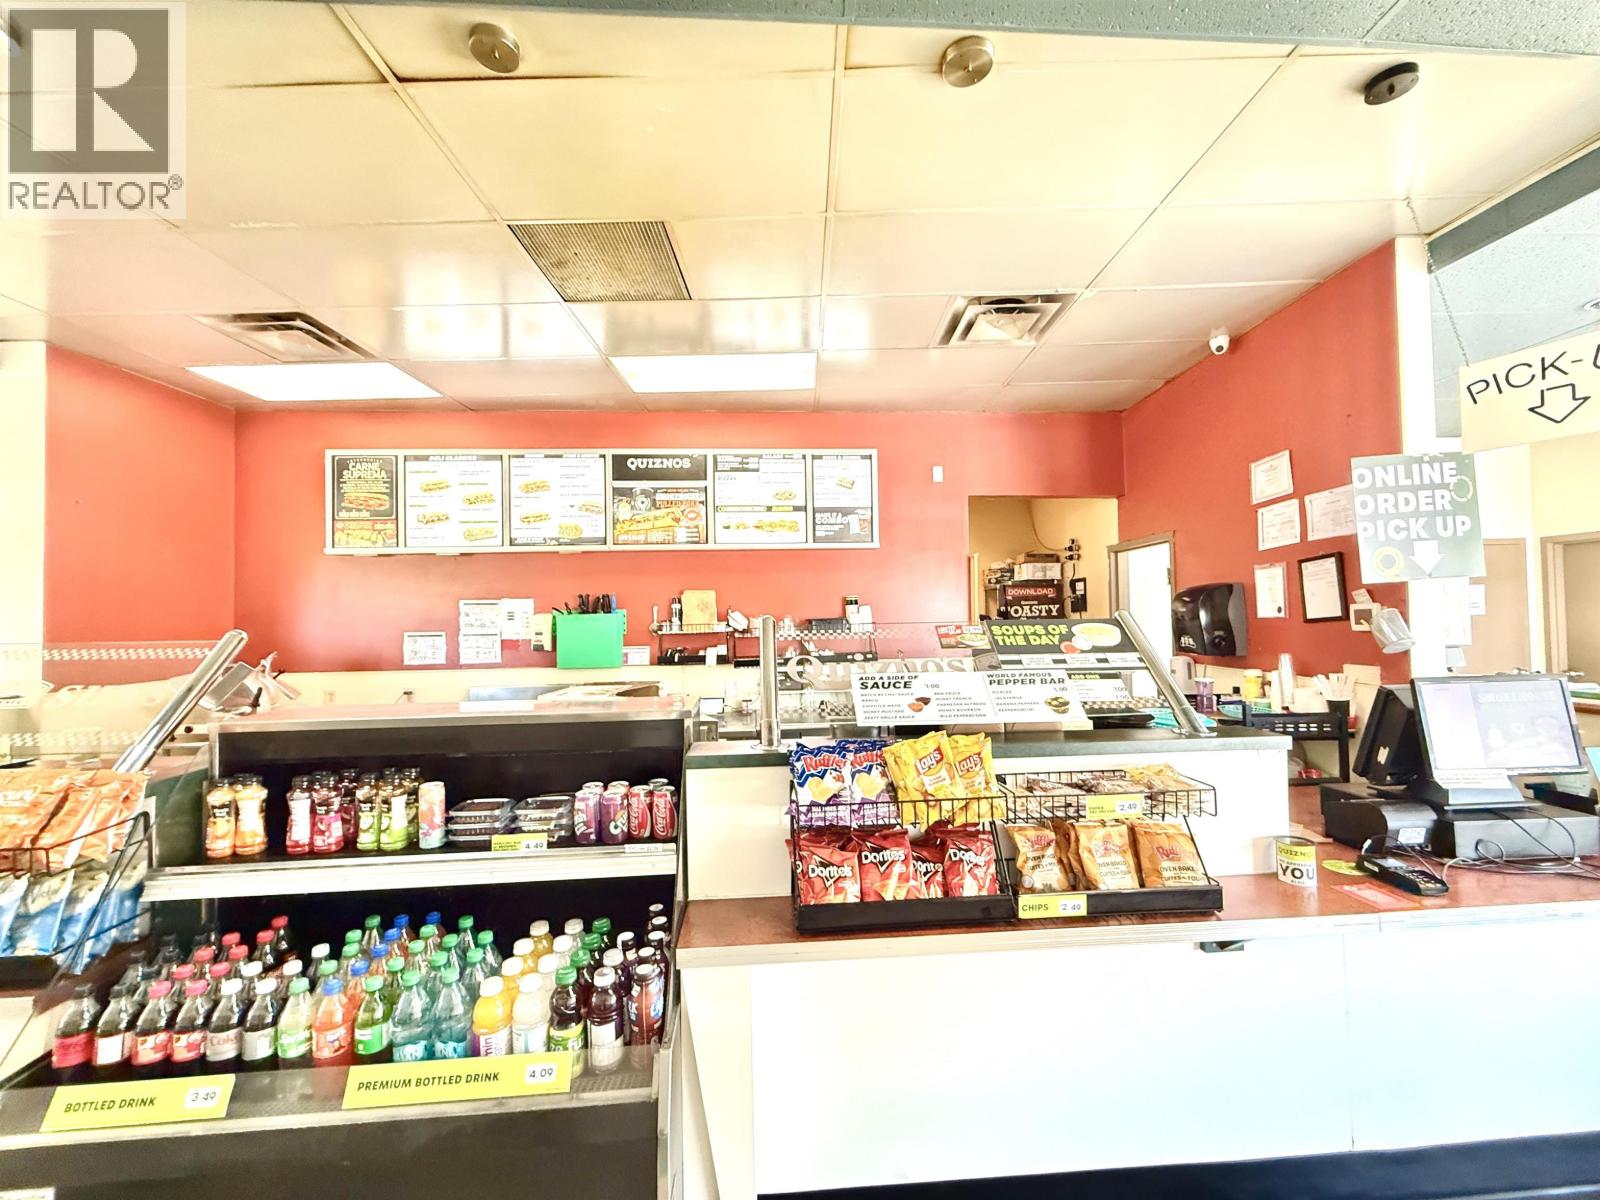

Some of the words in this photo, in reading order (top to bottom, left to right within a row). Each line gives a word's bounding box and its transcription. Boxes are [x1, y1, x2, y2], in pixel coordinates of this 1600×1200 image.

[627, 457, 691, 470] QUIZNOS
[342, 470, 387, 479] SUPREMA
[1353, 461, 1457, 489] ONLINE
[1355, 489, 1453, 515] ORDER
[1358, 517, 1430, 542] PICK
[1434, 515, 1471, 537] UP
[1007, 587, 1054, 596] DOWNLOAD
[991, 624, 1046, 635] SOUPS
[1047, 624, 1069, 635] OF
[994, 635, 1027, 646] THE
[1028, 634, 1060, 646] DAY
[860, 681, 912, 690] SAUCE
[989, 678, 1036, 686] PEPPER
[1040, 677, 1065, 685] BAR
[654, 797, 668, 836] Coca-Cola
[861, 849, 906, 864] Doritos
[808, 863, 853, 878] Doritos
[911, 860, 944, 872] Dorito
[1279, 862, 1315, 881] YOU
[1022, 903, 1049, 912] CHIPS
[357, 1079, 412, 1092] PREMIUM
[415, 1074, 462, 1087] BOTTLED
[465, 1072, 500, 1084] DRINK
[64, 1099, 116, 1113] BOTTLED
[118, 1097, 157, 1109] DRINK
